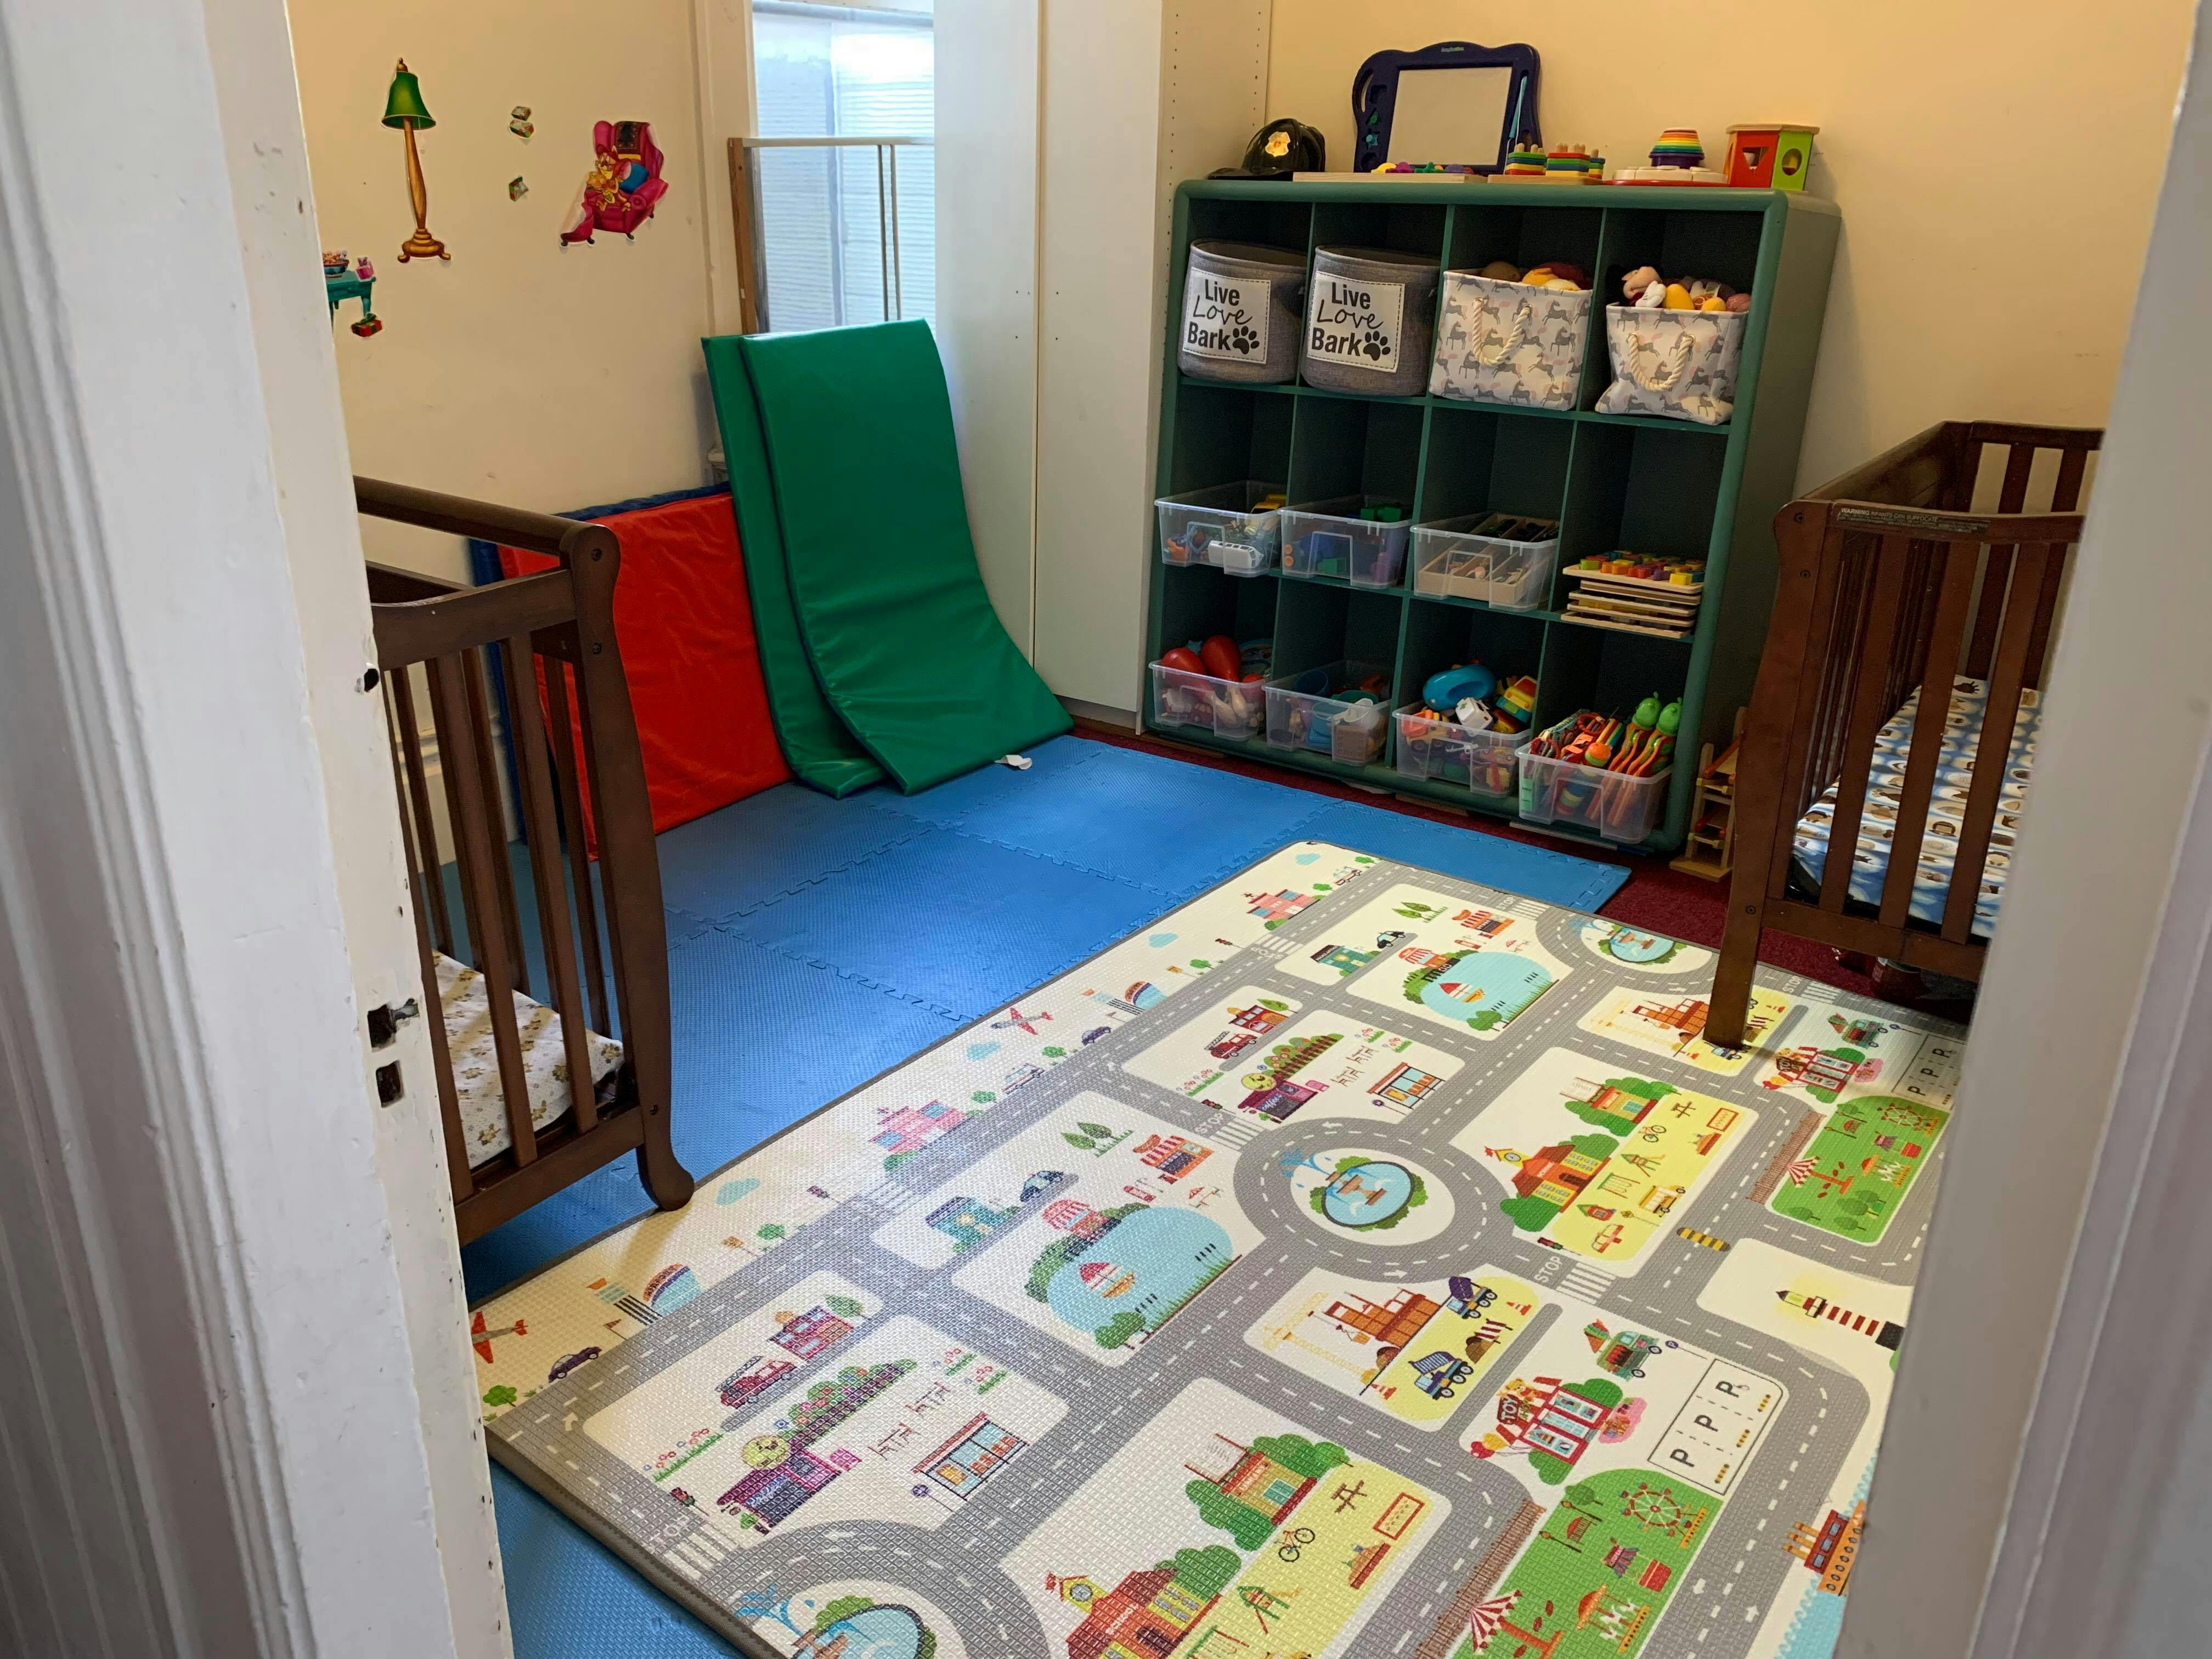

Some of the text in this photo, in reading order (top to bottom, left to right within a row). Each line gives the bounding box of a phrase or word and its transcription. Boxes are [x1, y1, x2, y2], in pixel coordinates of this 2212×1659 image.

[1205, 279, 1240, 306] Live
[1331, 282, 1370, 309] Live
[1193, 295, 1253, 325] Love
[1317, 299, 1384, 330] Love
[1187, 321, 1231, 351] Bark
[1311, 327, 1362, 357] Bark
[1841, 507, 1870, 516] WARNING
[1782, 975, 1803, 994] STOP
[1907, 1086, 1926, 1096] P
[1920, 1068, 1939, 1078] P
[1195, 1113, 1224, 1134] STOP
[1533, 1256, 1563, 1283] STOP
[1500, 1396, 1519, 1420] TOY
[1669, 1380, 1739, 1468] P P P
